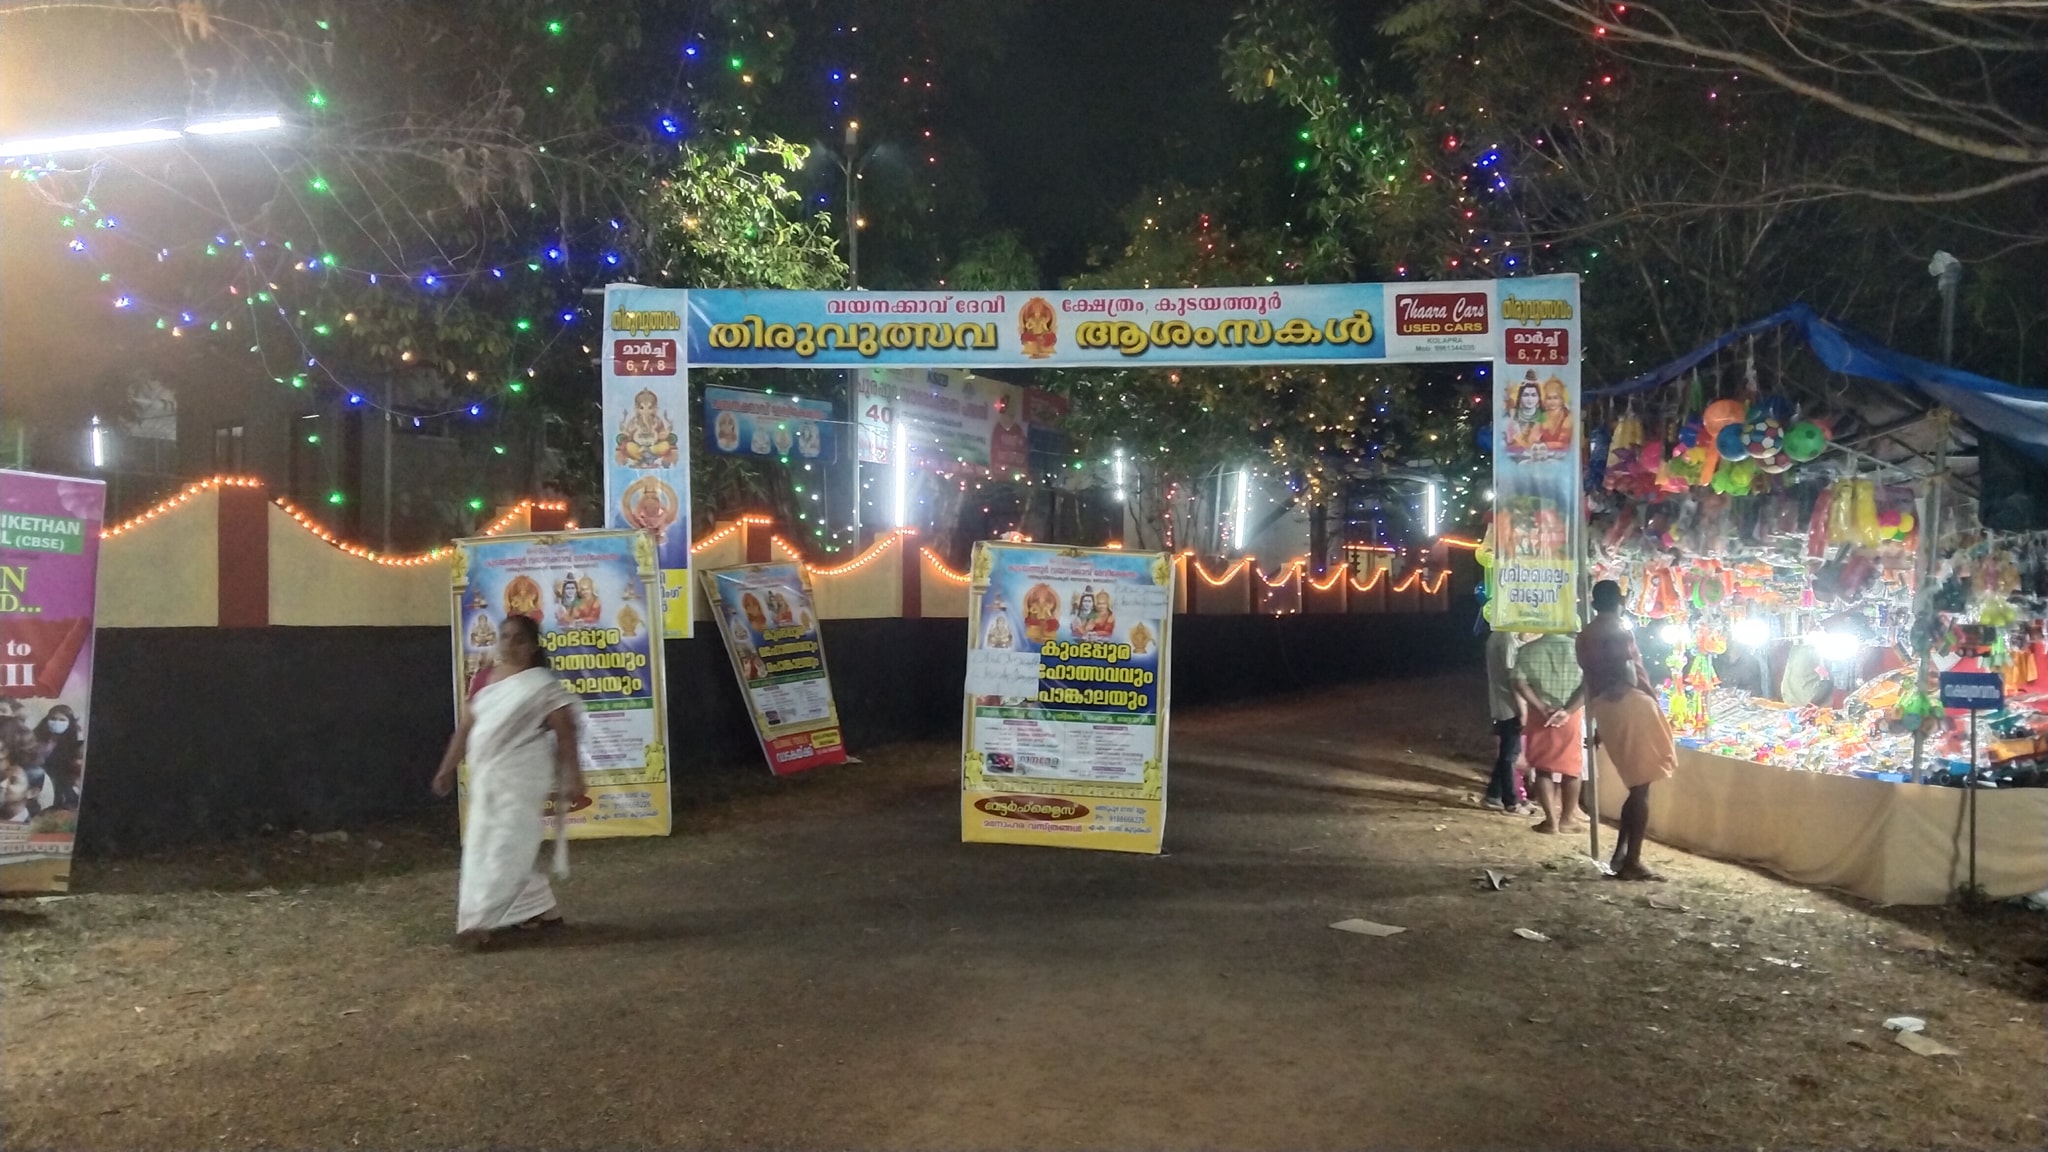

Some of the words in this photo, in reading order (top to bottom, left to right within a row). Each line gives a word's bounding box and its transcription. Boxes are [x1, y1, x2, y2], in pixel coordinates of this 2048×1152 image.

[827, 295, 954, 314] വയനക്കാവ്
[1154, 291, 1282, 316] കുടയത്തൂർ
[1399, 298, 1448, 321] Thaara
[1452, 297, 1486, 323] Cars
[708, 314, 999, 357] തിരുവുത്സവ
[1075, 309, 1375, 355] ആശംസകൾ
[1403, 323, 1441, 333] USED
[1444, 322, 1483, 332] CARS
[1513, 331, 1561, 347] മാർച്ച്
[622, 342, 670, 358] മാർച്ച്
[1549, 349, 1558, 360] 8
[657, 360, 666, 371] 8
[15, 535, 65, 552] (CBSE)
[6, 638, 32, 657] to
[1041, 640, 1132, 664] കുംഭപ്പൂര
[1038, 663, 1154, 688] ഹോത്സവവും
